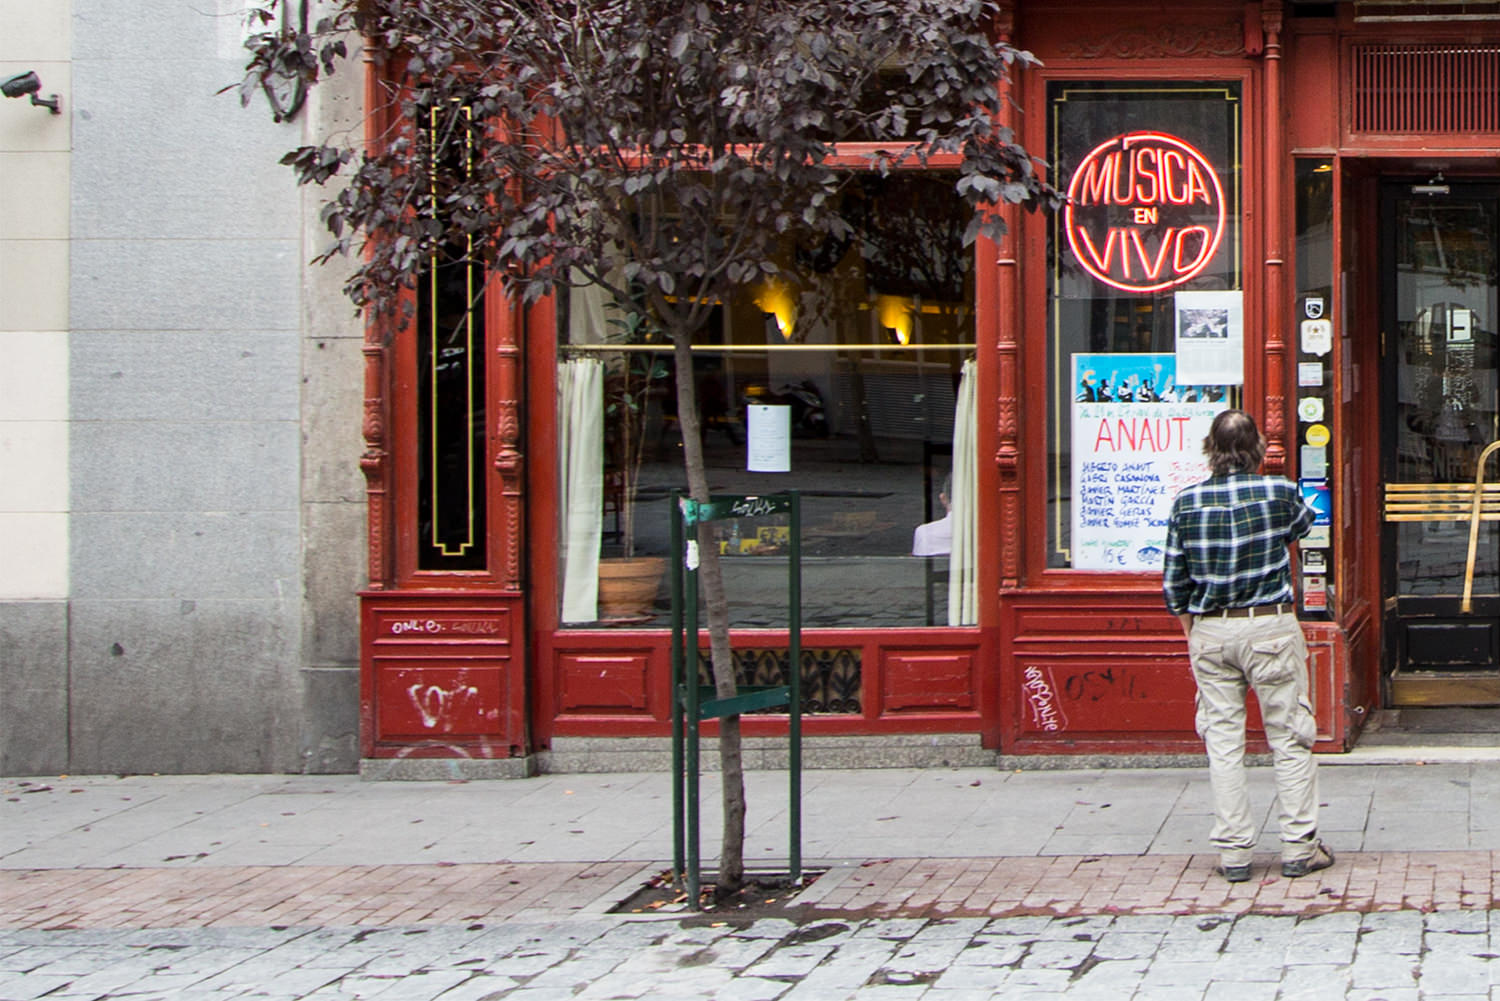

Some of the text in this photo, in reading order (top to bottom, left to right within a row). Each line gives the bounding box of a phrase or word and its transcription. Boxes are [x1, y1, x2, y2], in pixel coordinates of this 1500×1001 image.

[1133, 206, 1159, 225] EN
[1076, 224, 1213, 281] VIVO
[1094, 416, 1191, 453] ANAUT
